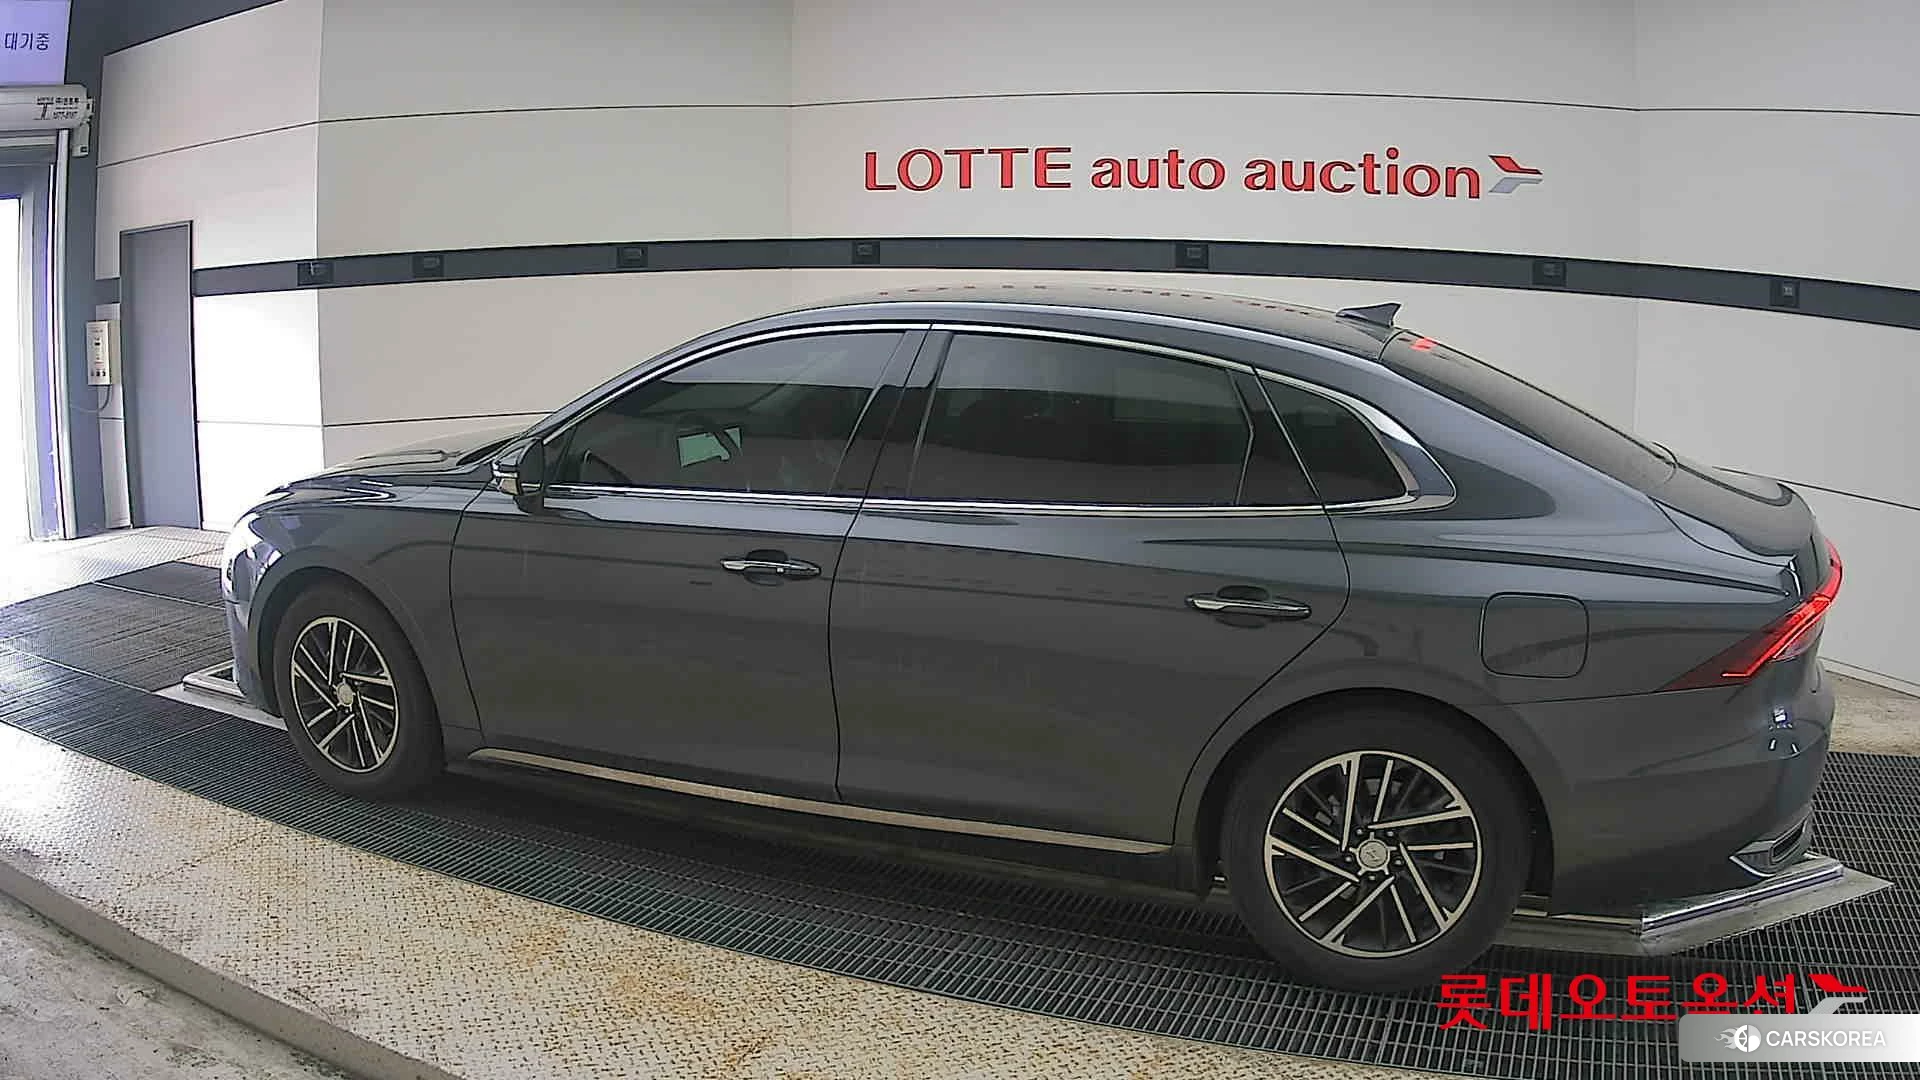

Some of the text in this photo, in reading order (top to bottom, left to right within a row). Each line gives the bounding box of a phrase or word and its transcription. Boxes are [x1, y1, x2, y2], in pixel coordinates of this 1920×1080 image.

[4, 32, 50, 51] 대기중
[864, 147, 1481, 199] LOTTE auto auction
